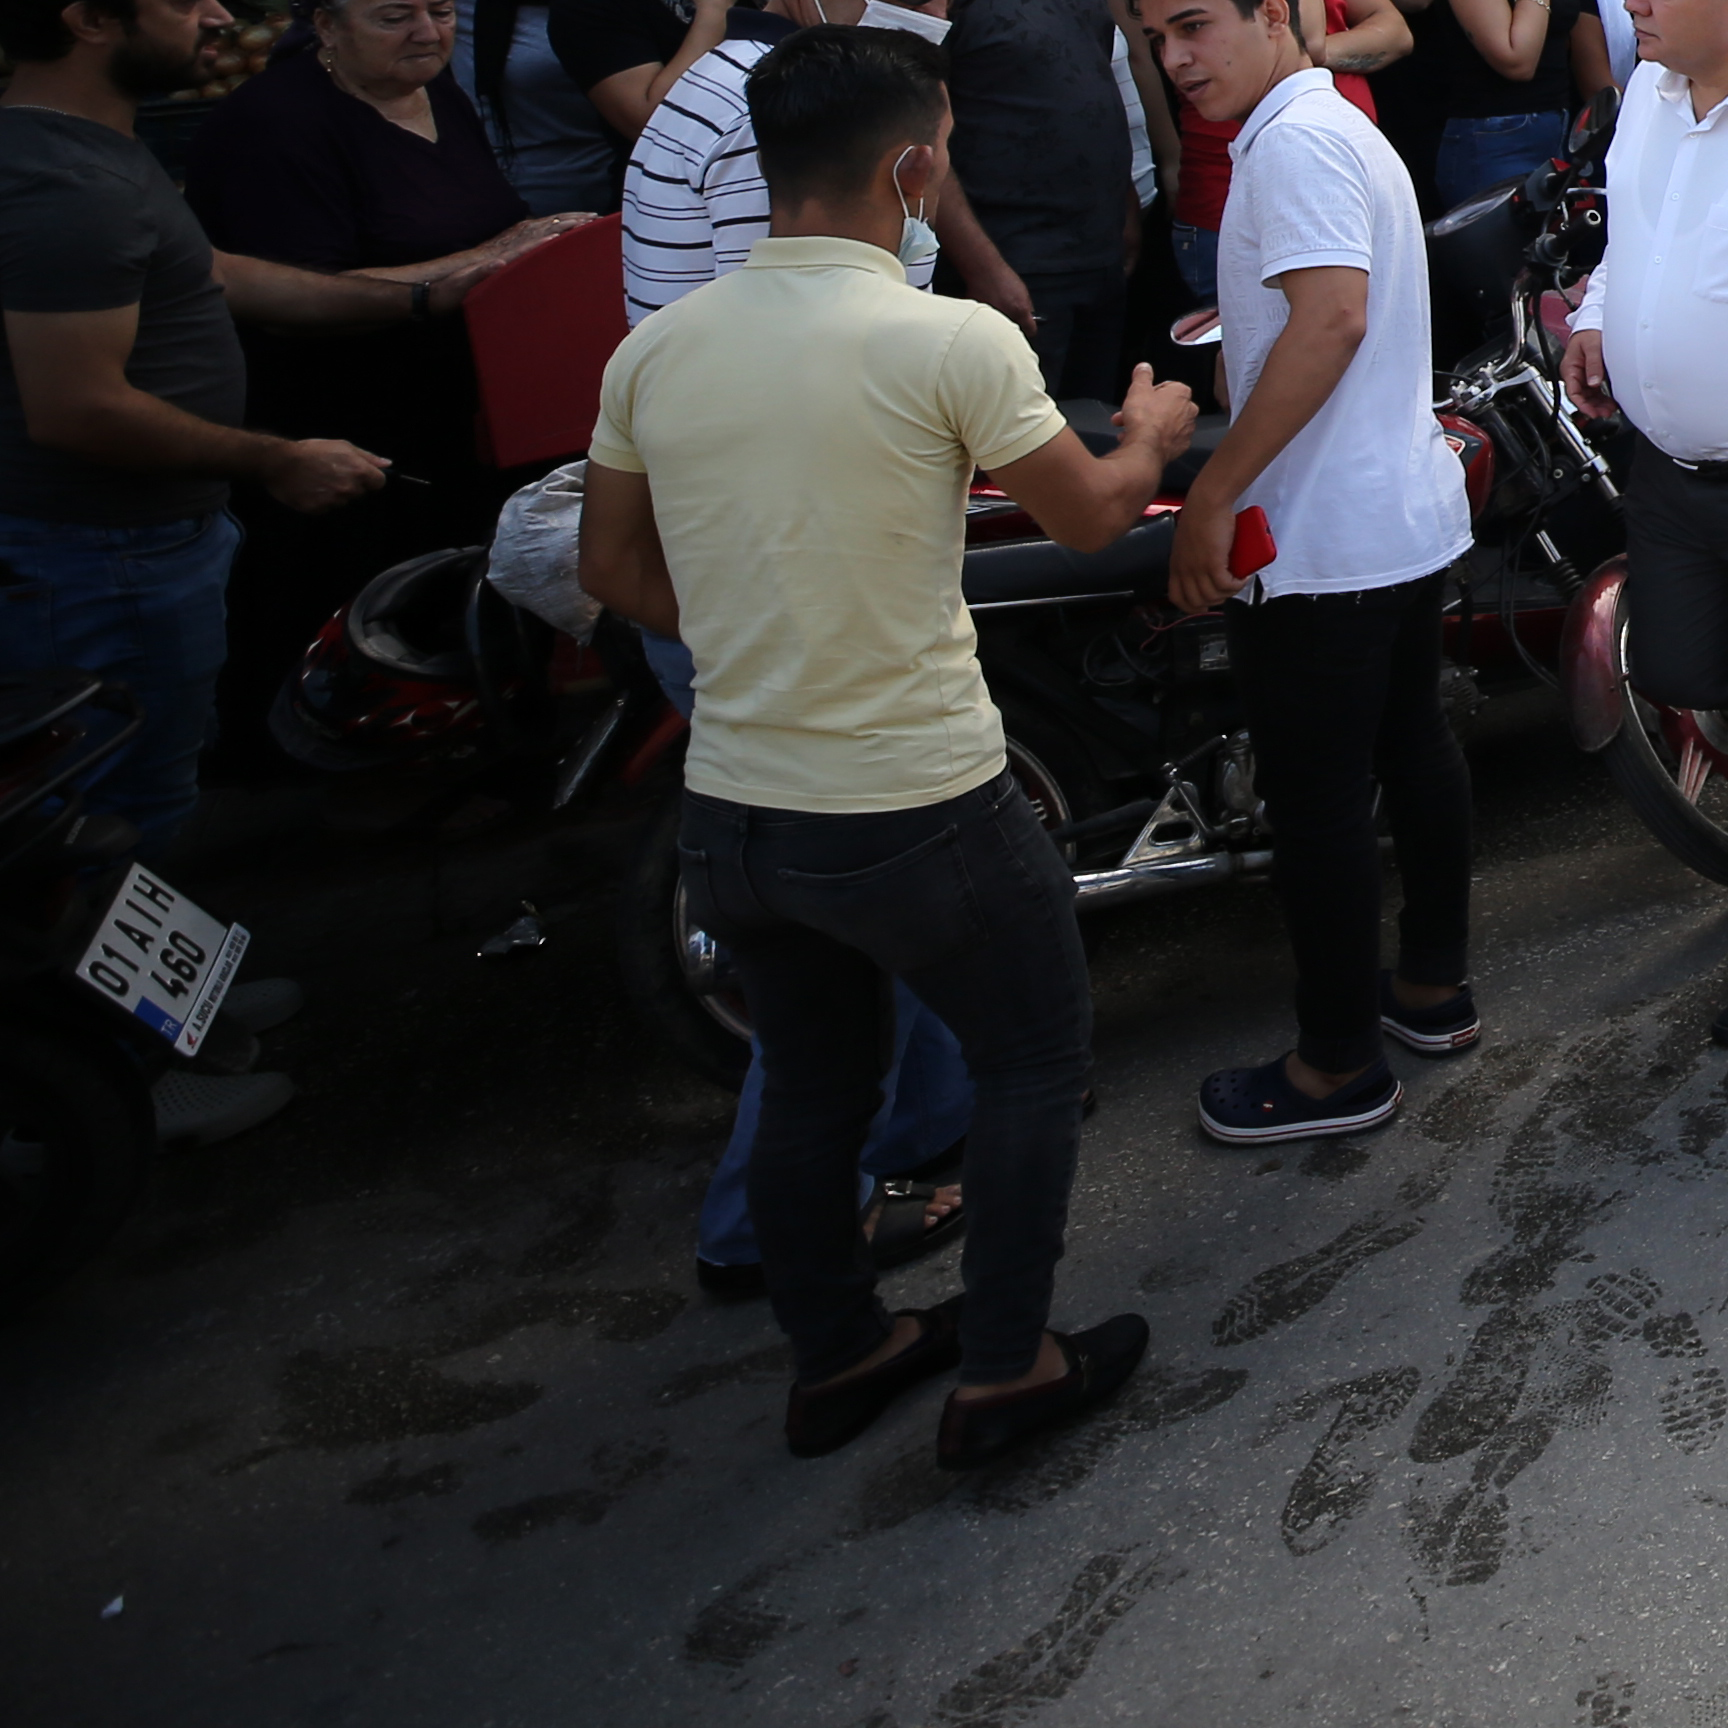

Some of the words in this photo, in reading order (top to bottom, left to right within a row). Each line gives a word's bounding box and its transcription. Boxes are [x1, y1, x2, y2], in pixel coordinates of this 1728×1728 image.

[88, 943, 140, 998] 01
[149, 930, 207, 1000] 460
[161, 1019, 178, 1036] TR
